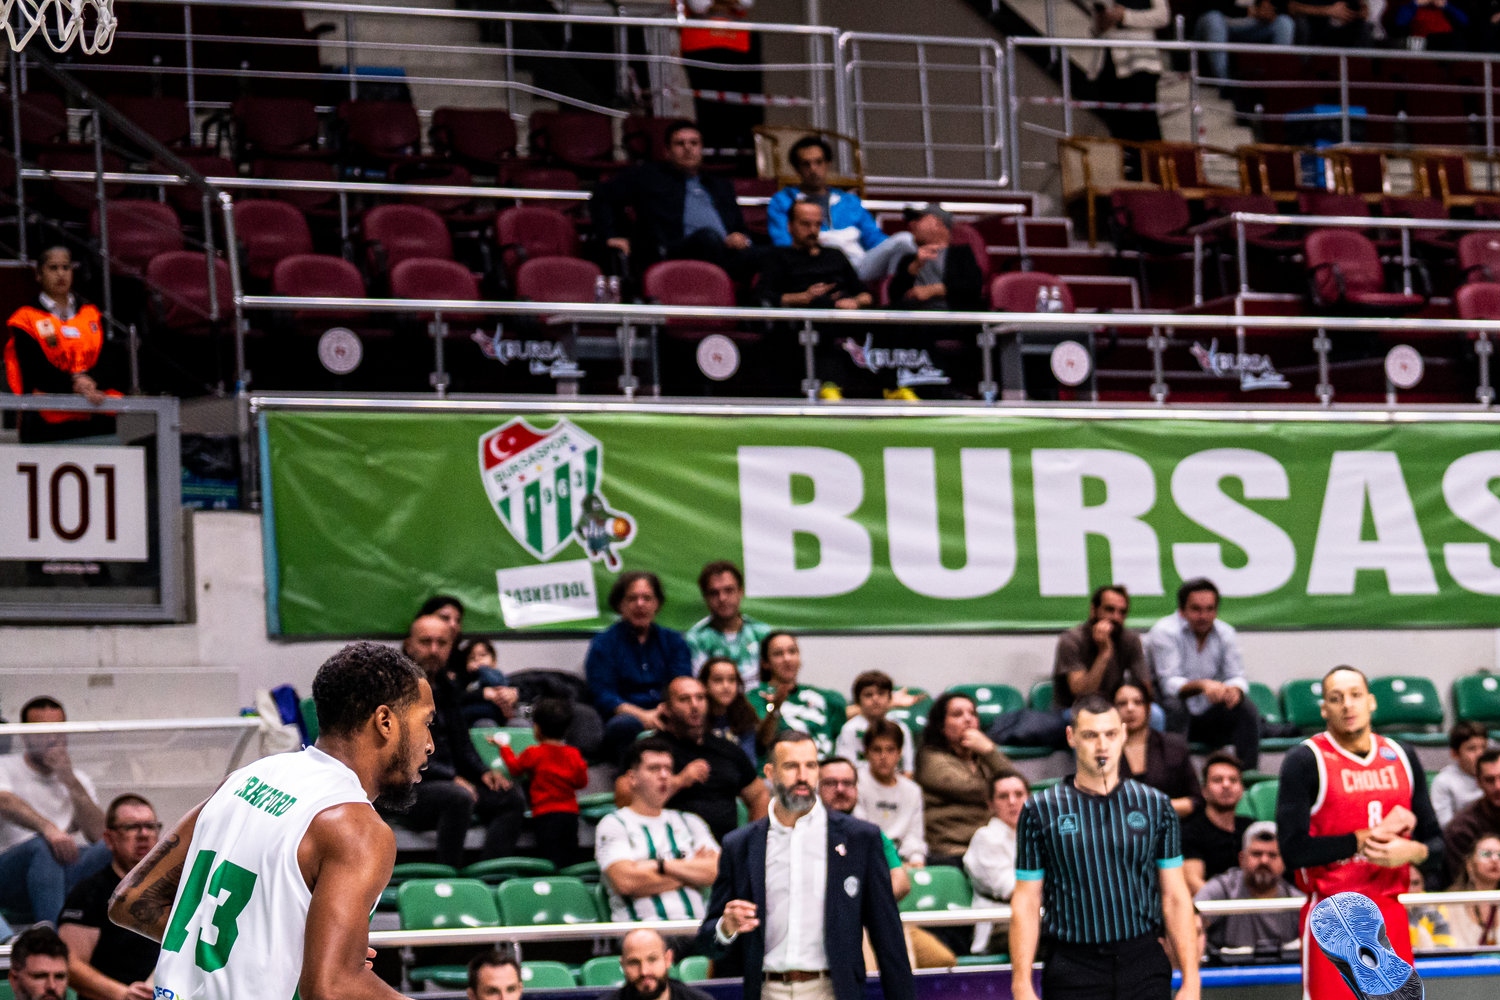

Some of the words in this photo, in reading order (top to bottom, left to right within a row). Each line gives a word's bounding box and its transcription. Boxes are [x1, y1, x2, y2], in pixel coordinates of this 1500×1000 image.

[17, 462, 117, 541] 101
[1340, 765, 1399, 793] CHOLET
[1367, 800, 1384, 830] 8
[162, 849, 258, 973] 13
